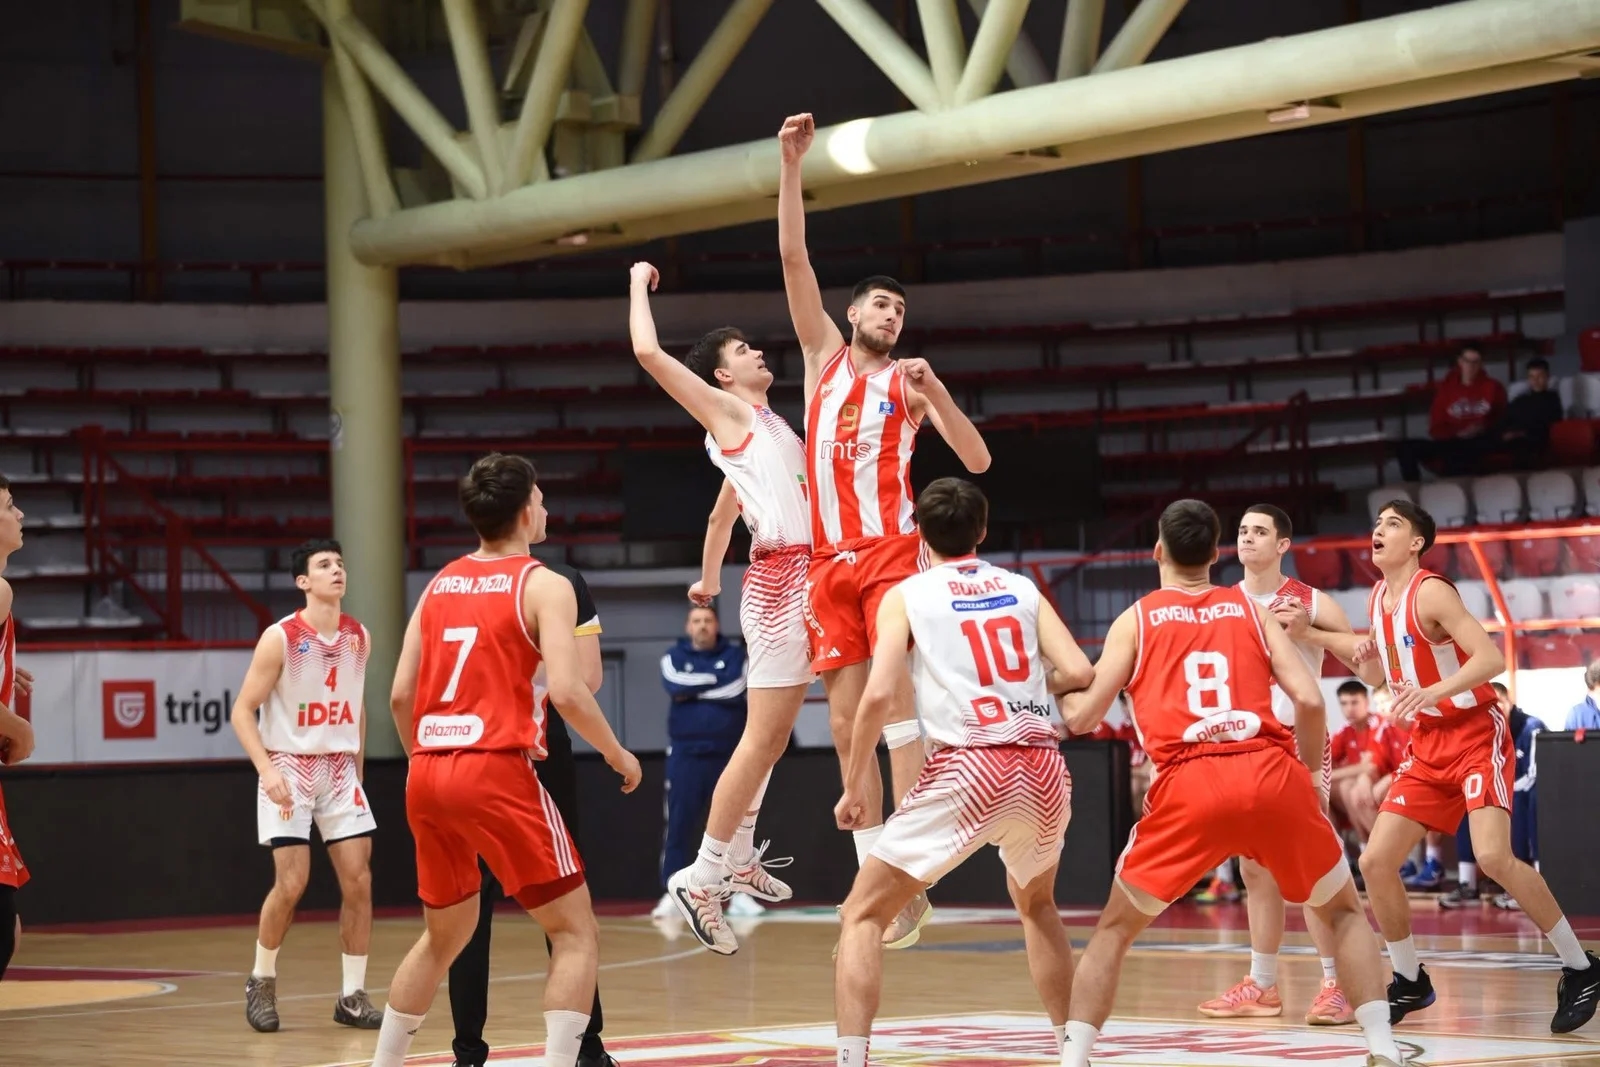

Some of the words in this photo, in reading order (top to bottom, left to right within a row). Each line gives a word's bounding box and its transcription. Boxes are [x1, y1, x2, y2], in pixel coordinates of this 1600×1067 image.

[839, 403, 860, 431] 9
[821, 438, 872, 461] mts
[432, 576, 474, 594] CRVENA
[472, 574, 513, 594] ZVEZDA
[1149, 605, 1198, 627] CRVENA
[1197, 602, 1246, 624] ZVEZDA
[440, 627, 478, 703] 7
[960, 615, 1031, 688] 10
[324, 666, 337, 692] 4
[1184, 651, 1232, 719] 8
[165, 688, 259, 735] trigl
[424, 724, 471, 739] plazma
